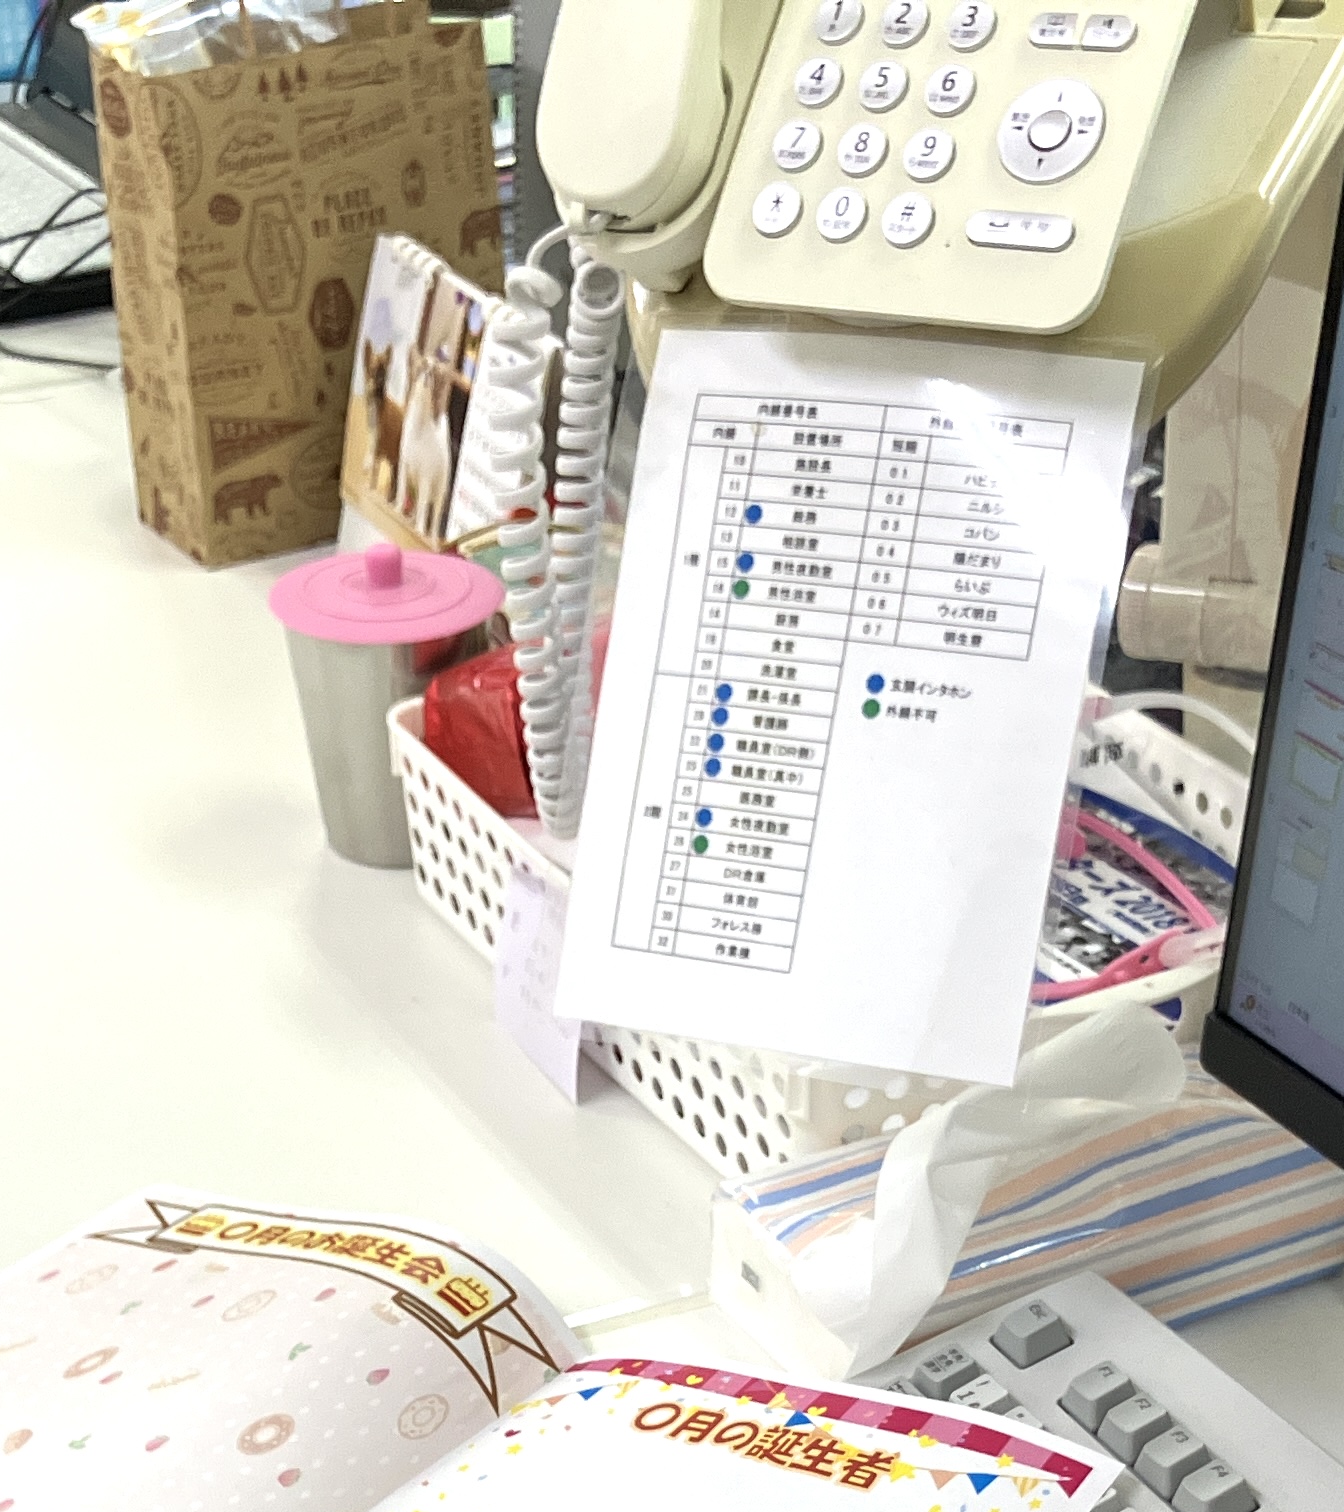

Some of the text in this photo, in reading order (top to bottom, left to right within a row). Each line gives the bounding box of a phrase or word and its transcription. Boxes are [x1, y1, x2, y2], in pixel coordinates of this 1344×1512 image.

[896, 3, 912, 24] 2
[962, 6, 978, 27] 3
[811, 64, 826, 85] 4
[875, 67, 890, 87] 5
[942, 71, 957, 92] 6
[791, 127, 807, 149] 7
[854, 132, 870, 153] 8
[921, 136, 937, 157] 9
[835, 196, 849, 217] 0
[1097, 1365, 1114, 1379] F1
[957, 1391, 975, 1400] 1
[1135, 1397, 1153, 1411] F2
[1170, 1430, 1190, 1444] F3
[1210, 1464, 1229, 1478] F4
